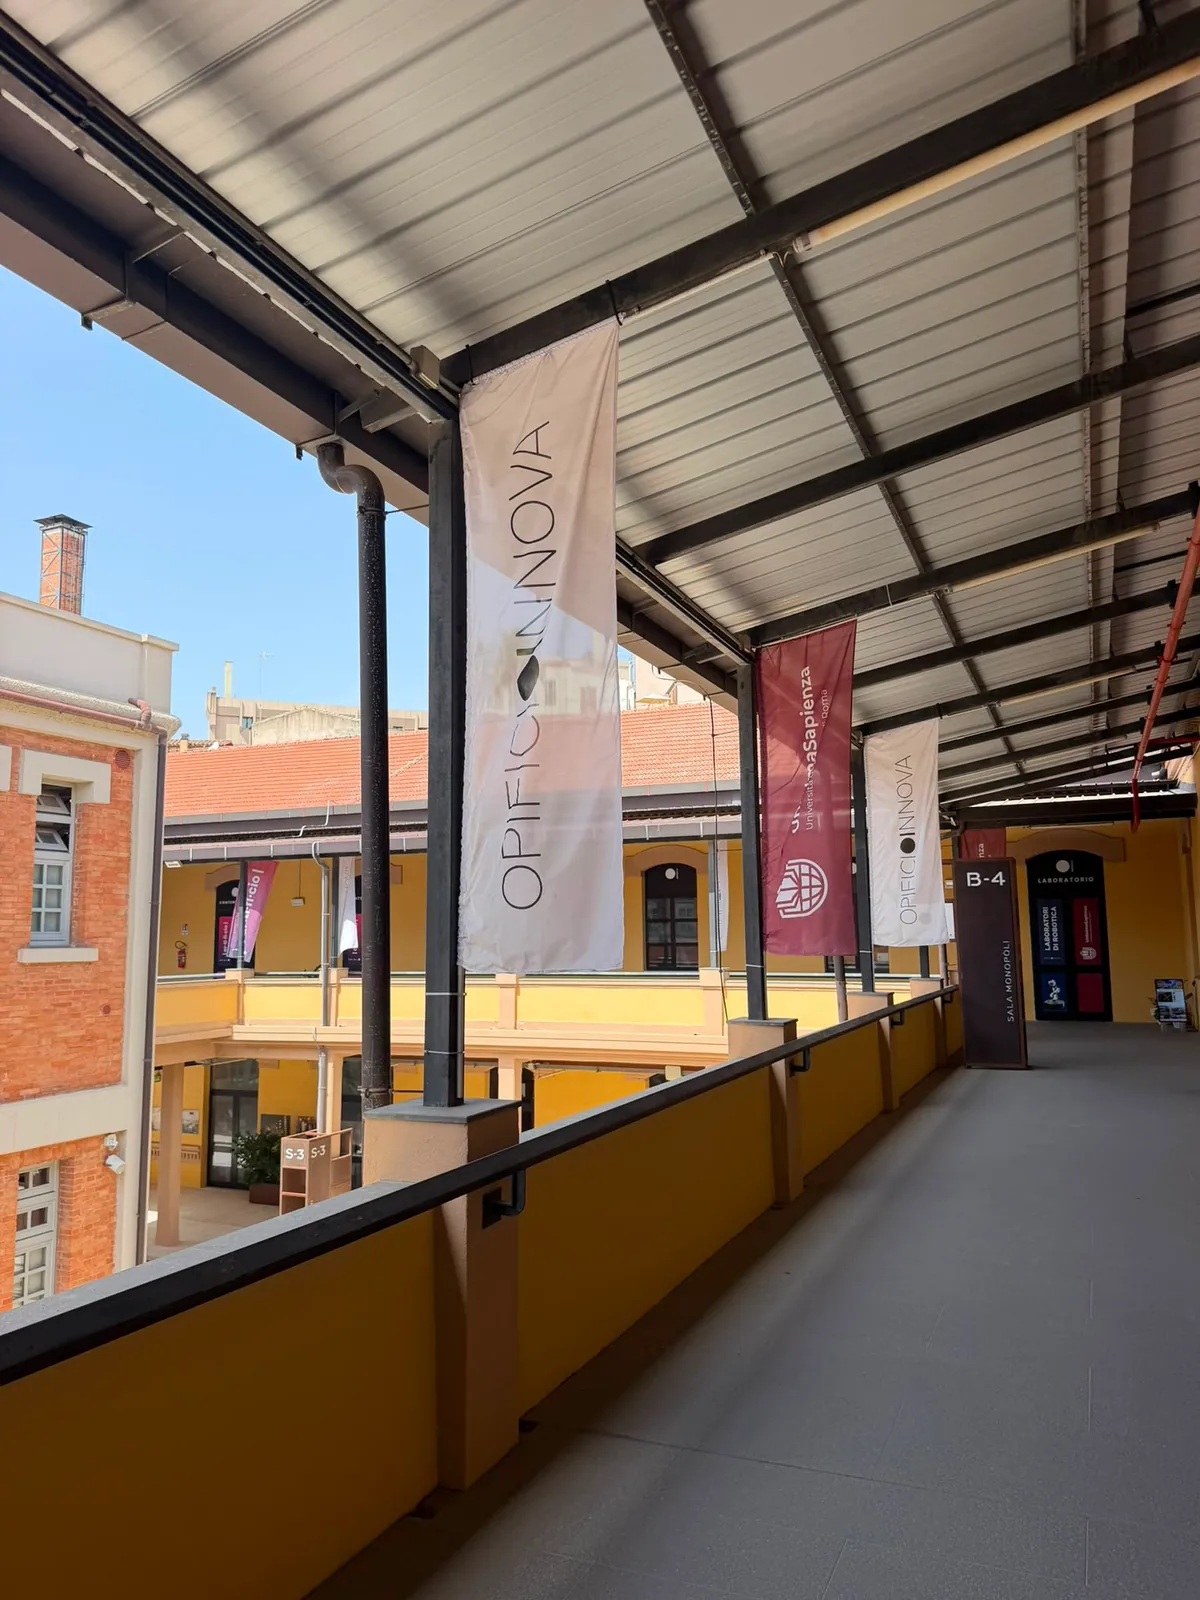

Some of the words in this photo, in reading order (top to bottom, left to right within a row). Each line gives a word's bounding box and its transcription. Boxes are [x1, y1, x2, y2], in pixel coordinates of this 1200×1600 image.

[820, 689, 829, 719] Roma
[966, 871, 1006, 887] B-4
[1037, 876, 1095, 884] LABORATORIO
[1042, 906, 1051, 951] LABORATORI
[1051, 906, 1059, 942] ROBOTICA
[1053, 943, 1059, 951] DI
[1006, 995, 1015, 1023] SALA
[285, 1148, 305, 1160] S-3
[311, 1145, 326, 1158] S-3
